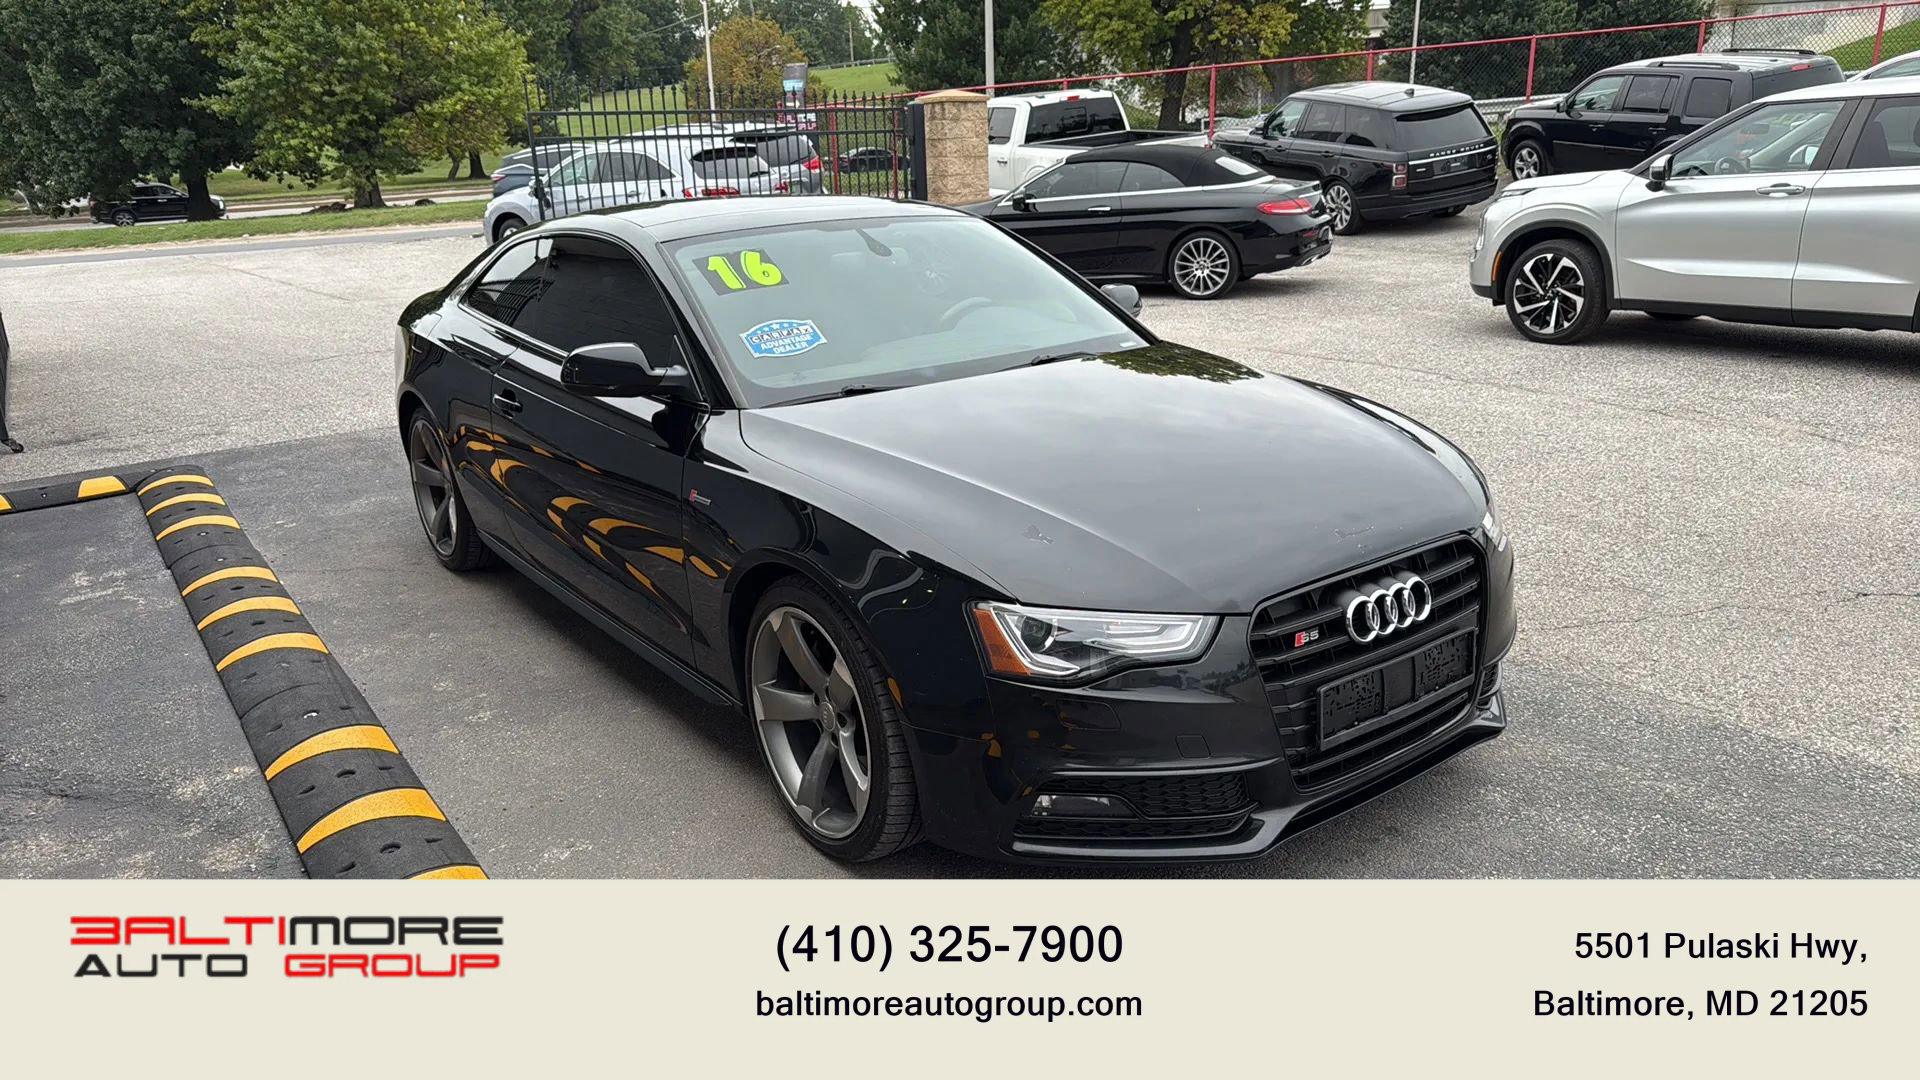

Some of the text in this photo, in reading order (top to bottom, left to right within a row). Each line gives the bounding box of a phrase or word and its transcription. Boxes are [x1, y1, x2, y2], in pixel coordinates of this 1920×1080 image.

[707, 250, 782, 290] 16
[750, 325, 813, 344] CARFAX
[760, 334, 812, 350] ADVANTAGE
[773, 341, 809, 354] DEALER
